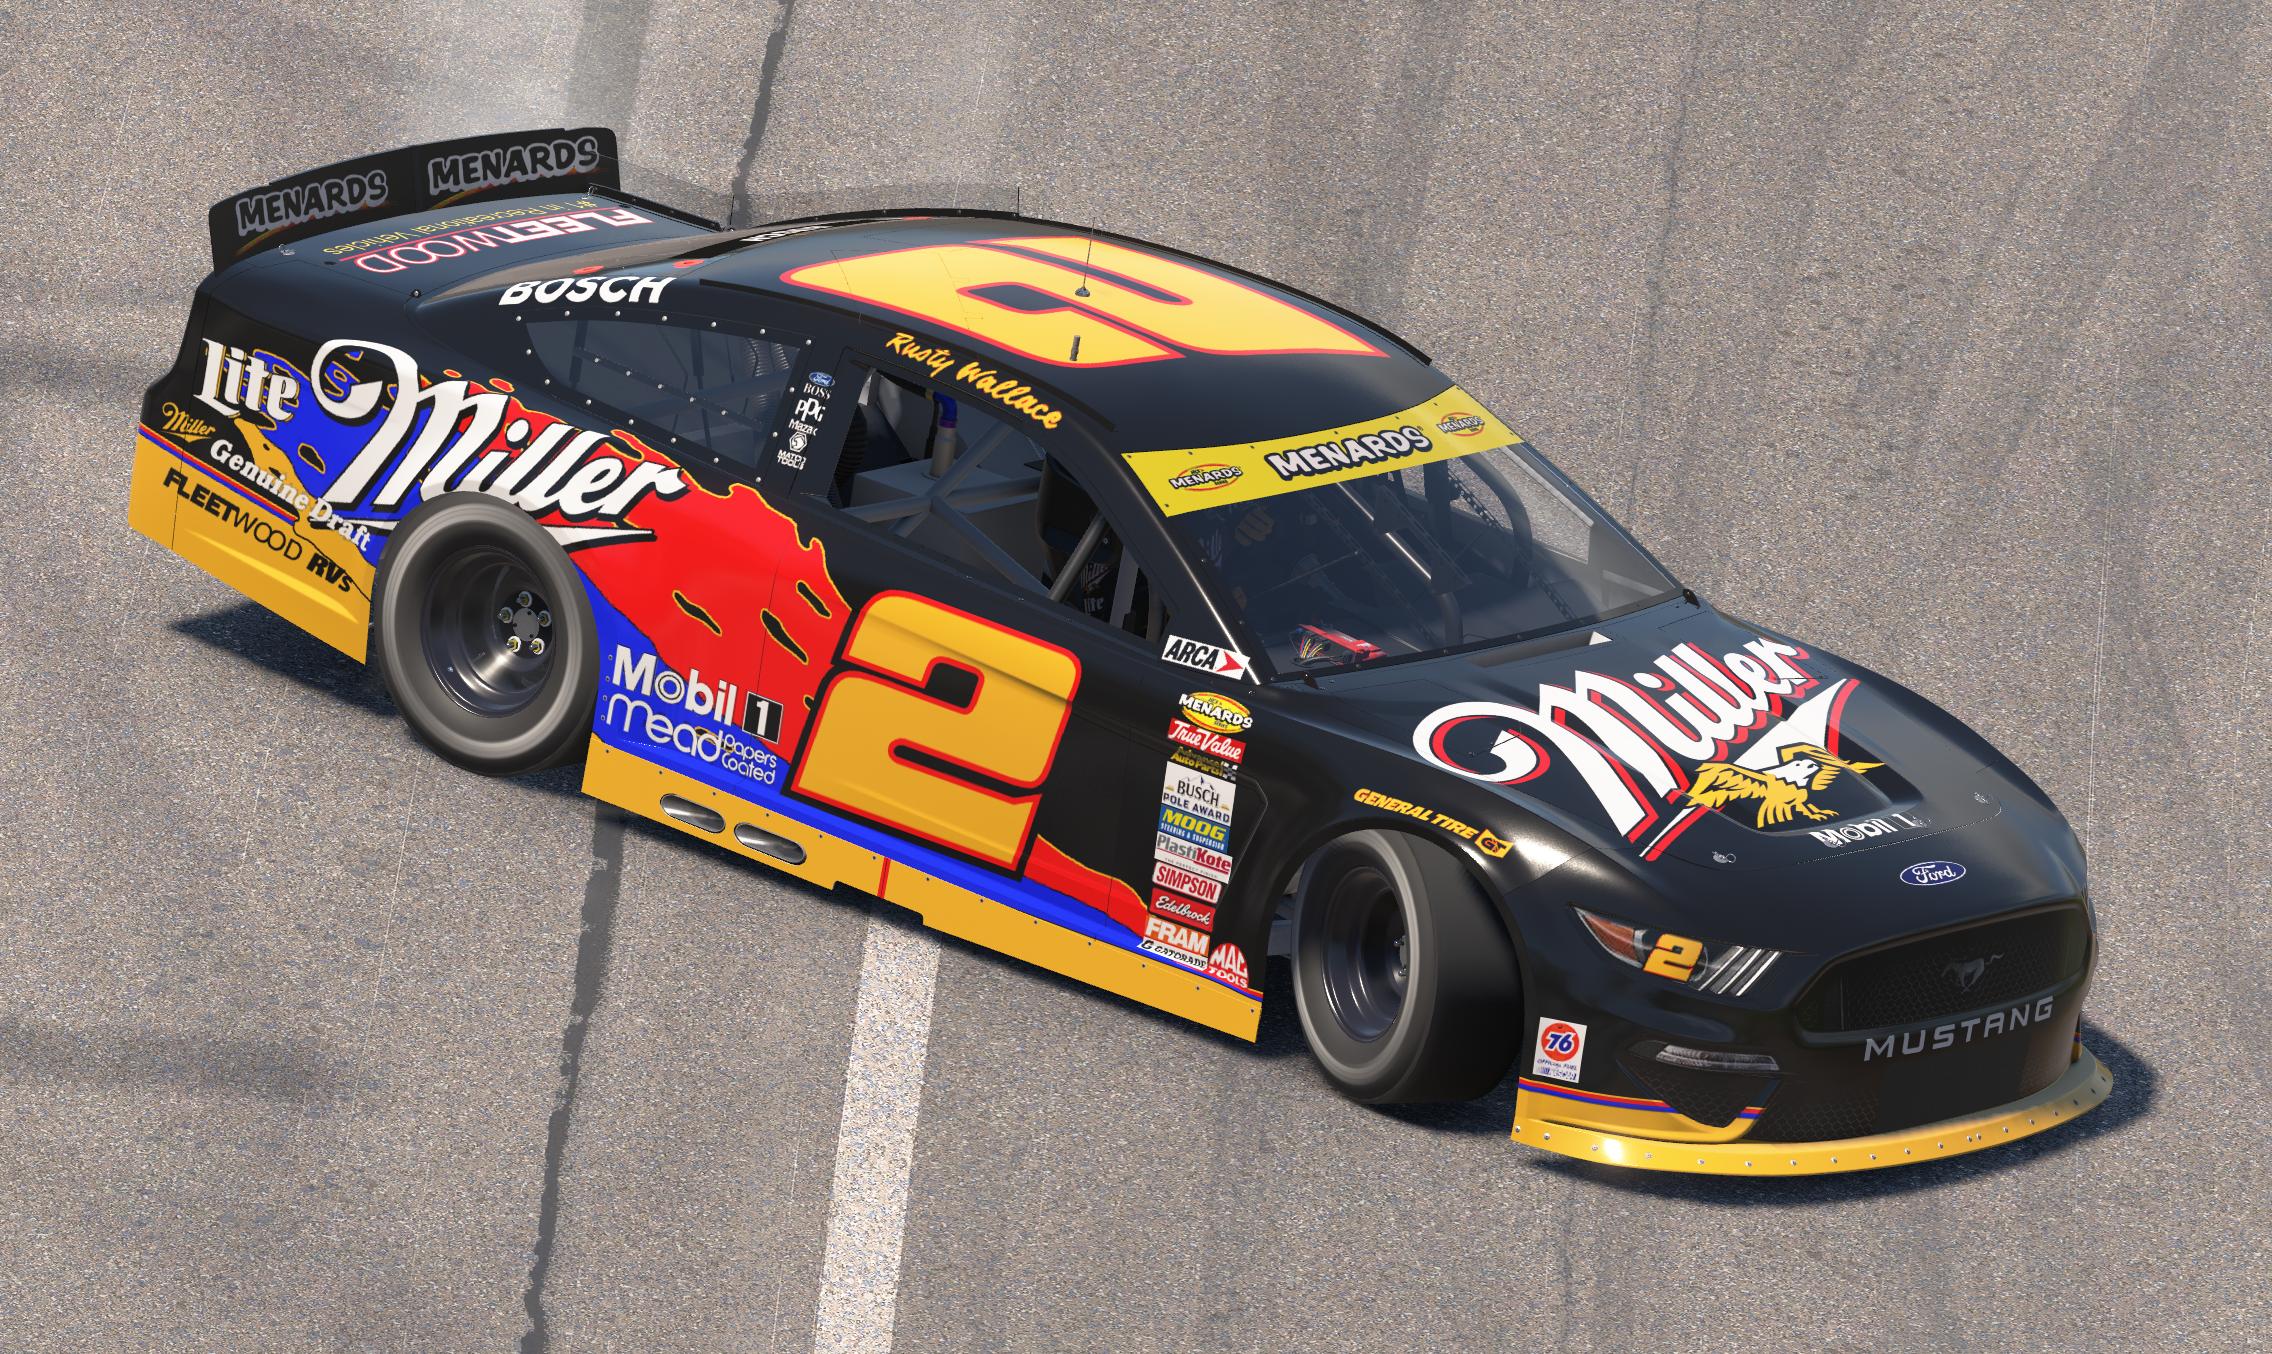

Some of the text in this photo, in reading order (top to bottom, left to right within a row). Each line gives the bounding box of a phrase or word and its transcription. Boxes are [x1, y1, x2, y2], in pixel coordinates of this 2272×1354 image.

[428, 136, 600, 196] MENARDS
[236, 169, 388, 236] MENARDS
[411, 206, 546, 235] Recreational
[323, 231, 411, 255] Vehicles
[352, 208, 655, 275] FLEETWOOD
[499, 276, 677, 306] BOSCH
[779, 235, 1391, 369] 2
[193, 337, 299, 421] Lite
[803, 383, 832, 400] BOSS
[885, 332, 1063, 429] Rusty Wallace
[162, 402, 216, 436] Miller
[311, 338, 688, 518] Miller
[1436, 416, 1485, 434] MENARDS
[1264, 427, 1432, 481] MENARDS
[210, 439, 371, 551] Genuine Draft
[1168, 466, 1243, 489] MENARDS
[162, 467, 303, 561] FLEETWOOD
[1163, 638, 1220, 670] ARCA
[612, 643, 770, 736] Mobil 1
[606, 692, 724, 763] mead
[1179, 693, 1254, 729] MENARDS
[790, 589, 1082, 872] 2
[1412, 637, 1810, 843] Miller
[1163, 792, 1231, 824] POLE AWARD
[1177, 779, 1221, 808] BUSCH
[1162, 808, 1227, 842] MOOG
[1353, 787, 1434, 822] GENERAL
[1430, 813, 1480, 840] TIRE
[1808, 817, 1898, 848] Mobil
[1156, 833, 1232, 872] PlastiKote
[1156, 865, 1218, 901] SIMPSON
[1911, 863, 1957, 884] Ford
[1155, 895, 1211, 925] Edelbrock
[1145, 916, 1210, 956] FRAM
[1154, 945, 1208, 969] GATORADE
[1210, 944, 1249, 979] MAC
[1642, 932, 1704, 984] 2
[1209, 966, 1249, 989] TOOLS
[1547, 1032, 1573, 1052] 76
[1863, 996, 2054, 1062] MUSTANG
